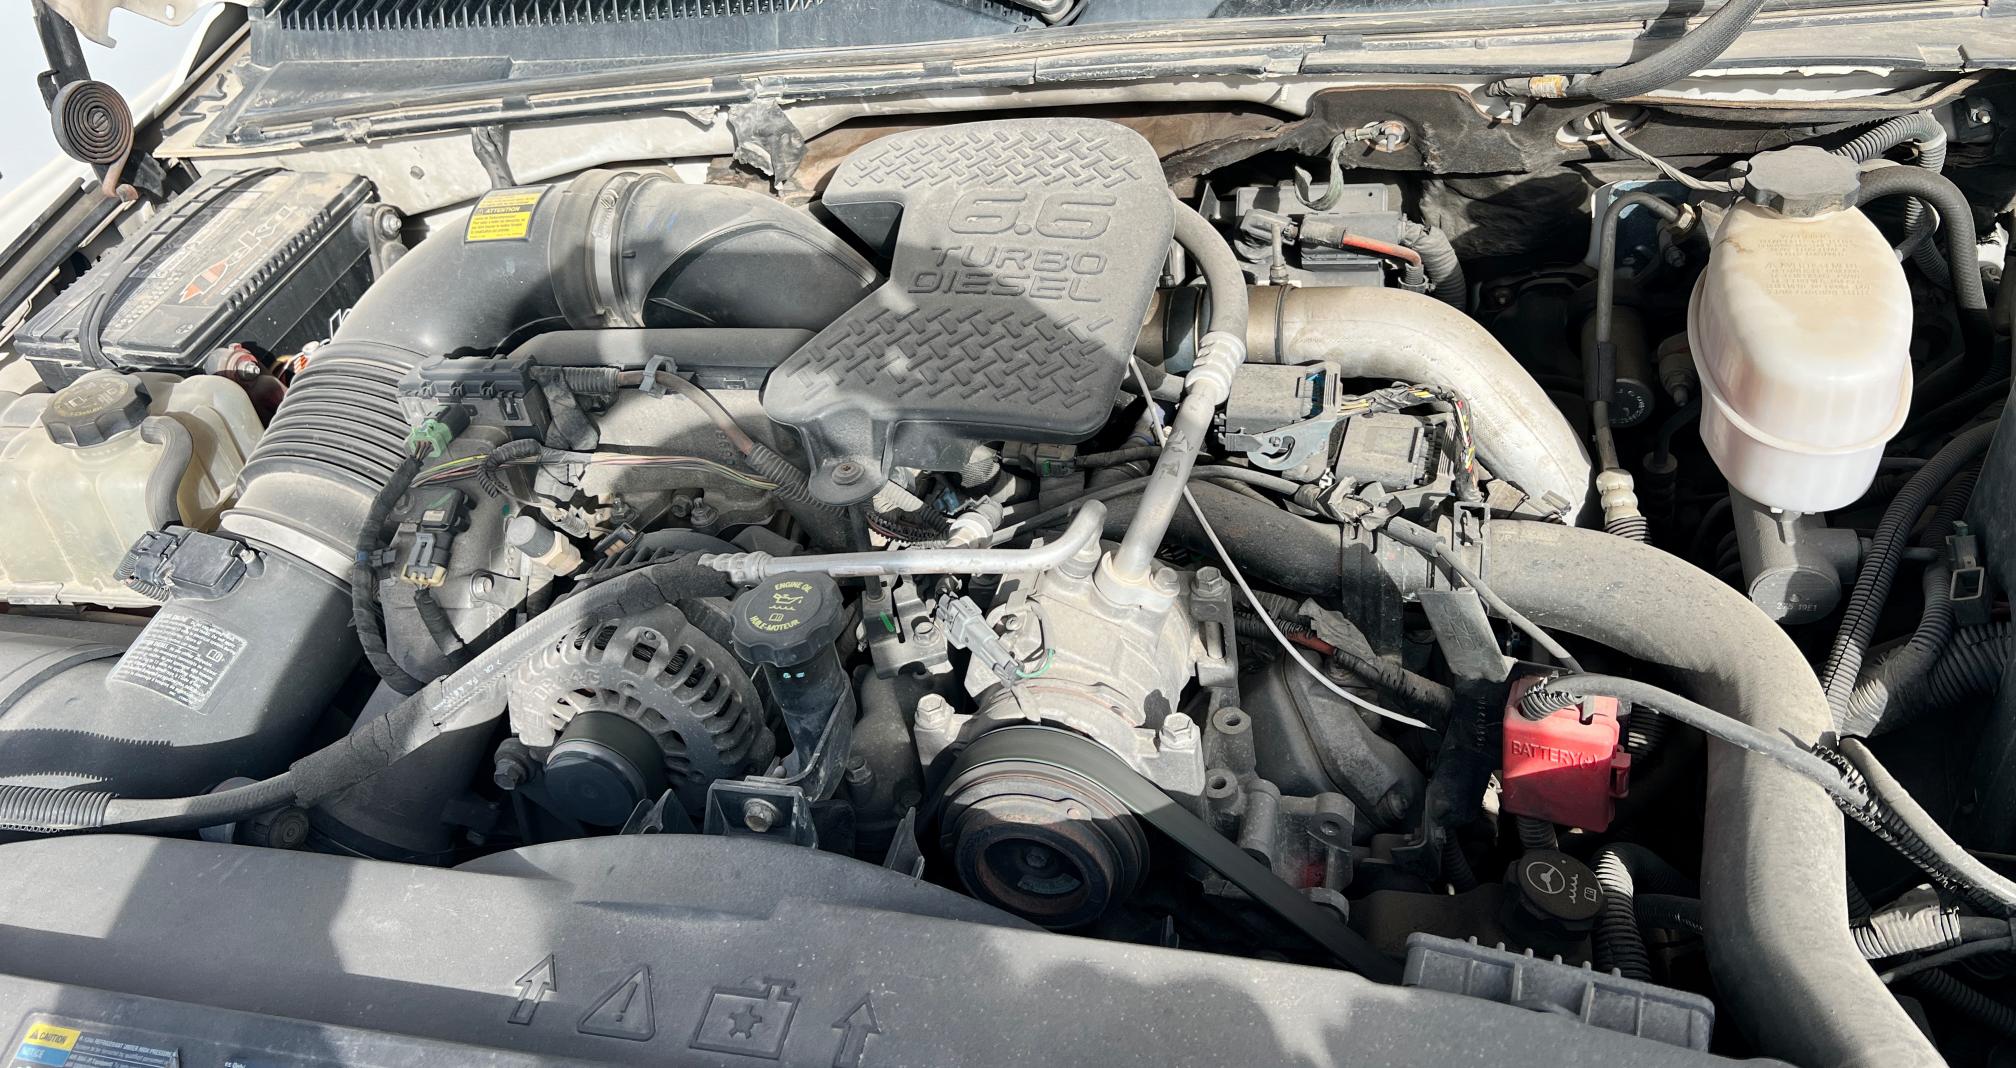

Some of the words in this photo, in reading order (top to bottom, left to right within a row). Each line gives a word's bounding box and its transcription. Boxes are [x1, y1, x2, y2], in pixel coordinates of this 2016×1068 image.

[486, 206, 521, 215] ATTENTION
[949, 190, 1118, 240] 6.6
[931, 245, 1108, 275] TURBO
[908, 270, 1102, 302] DIESEL
[774, 581, 804, 591] ENGINE
[801, 583, 814, 593] OIL
[749, 615, 801, 632] HUILE-MOTEUR
[39, 1031, 68, 1044] CAUTION
